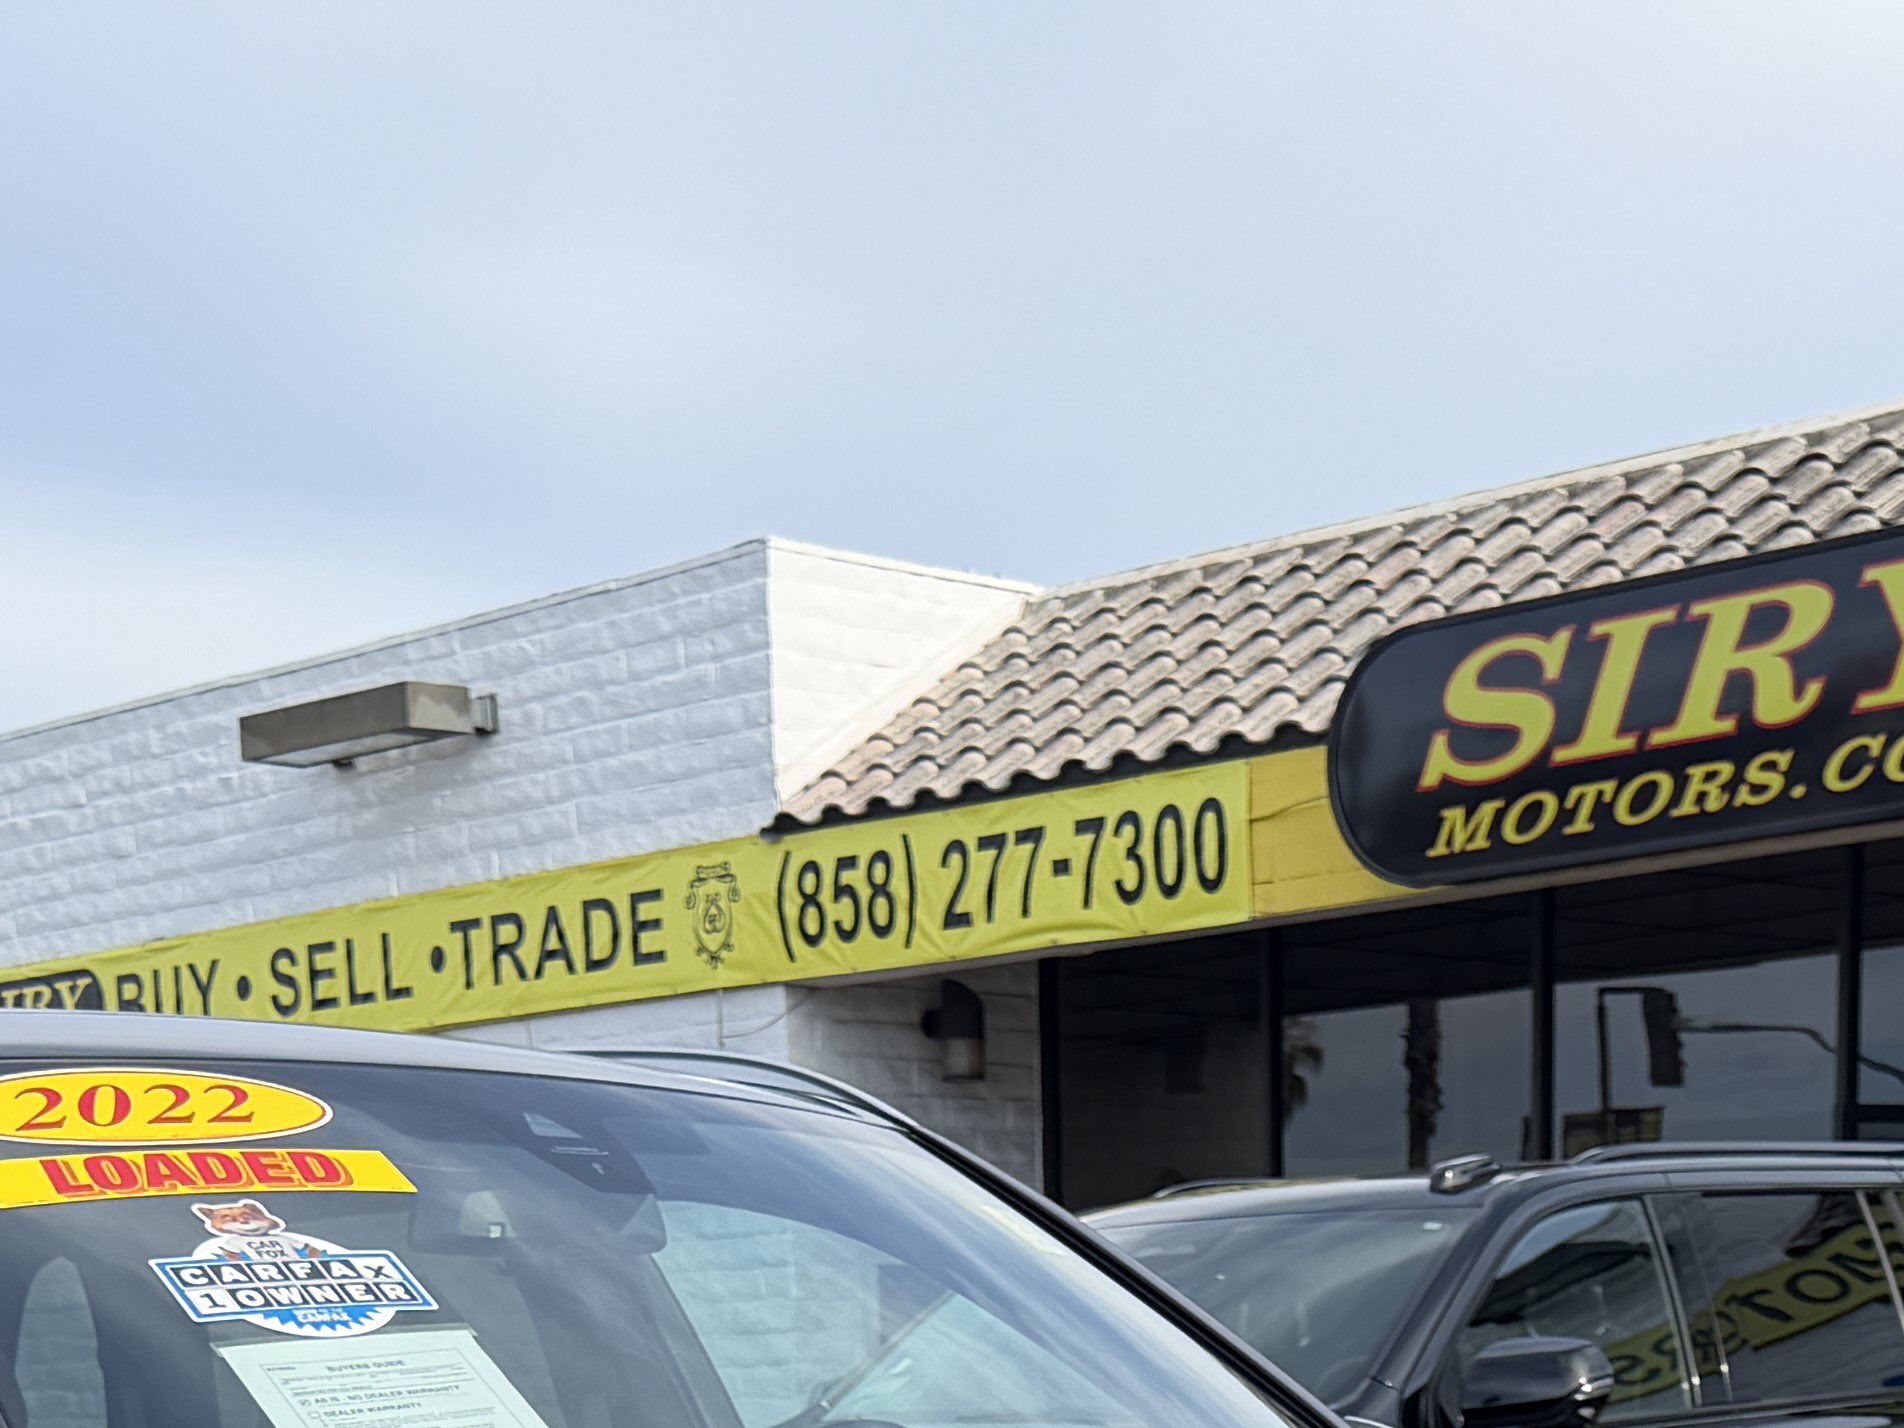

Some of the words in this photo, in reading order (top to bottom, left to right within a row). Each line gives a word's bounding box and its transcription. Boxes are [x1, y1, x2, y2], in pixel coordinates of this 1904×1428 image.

[777, 834, 915, 962] (858)
[941, 798, 1228, 930] 277-7300
[117, 959, 220, 1016] BUY
[270, 932, 413, 1016] SELL
[450, 888, 666, 991] TRADE
[14, 1084, 254, 1131] 2022
[39, 1151, 354, 1197] LOADED
[178, 1260, 394, 1286] CARFAX
[199, 1292, 227, 1309] 1
[235, 1282, 411, 1308] OWNER
